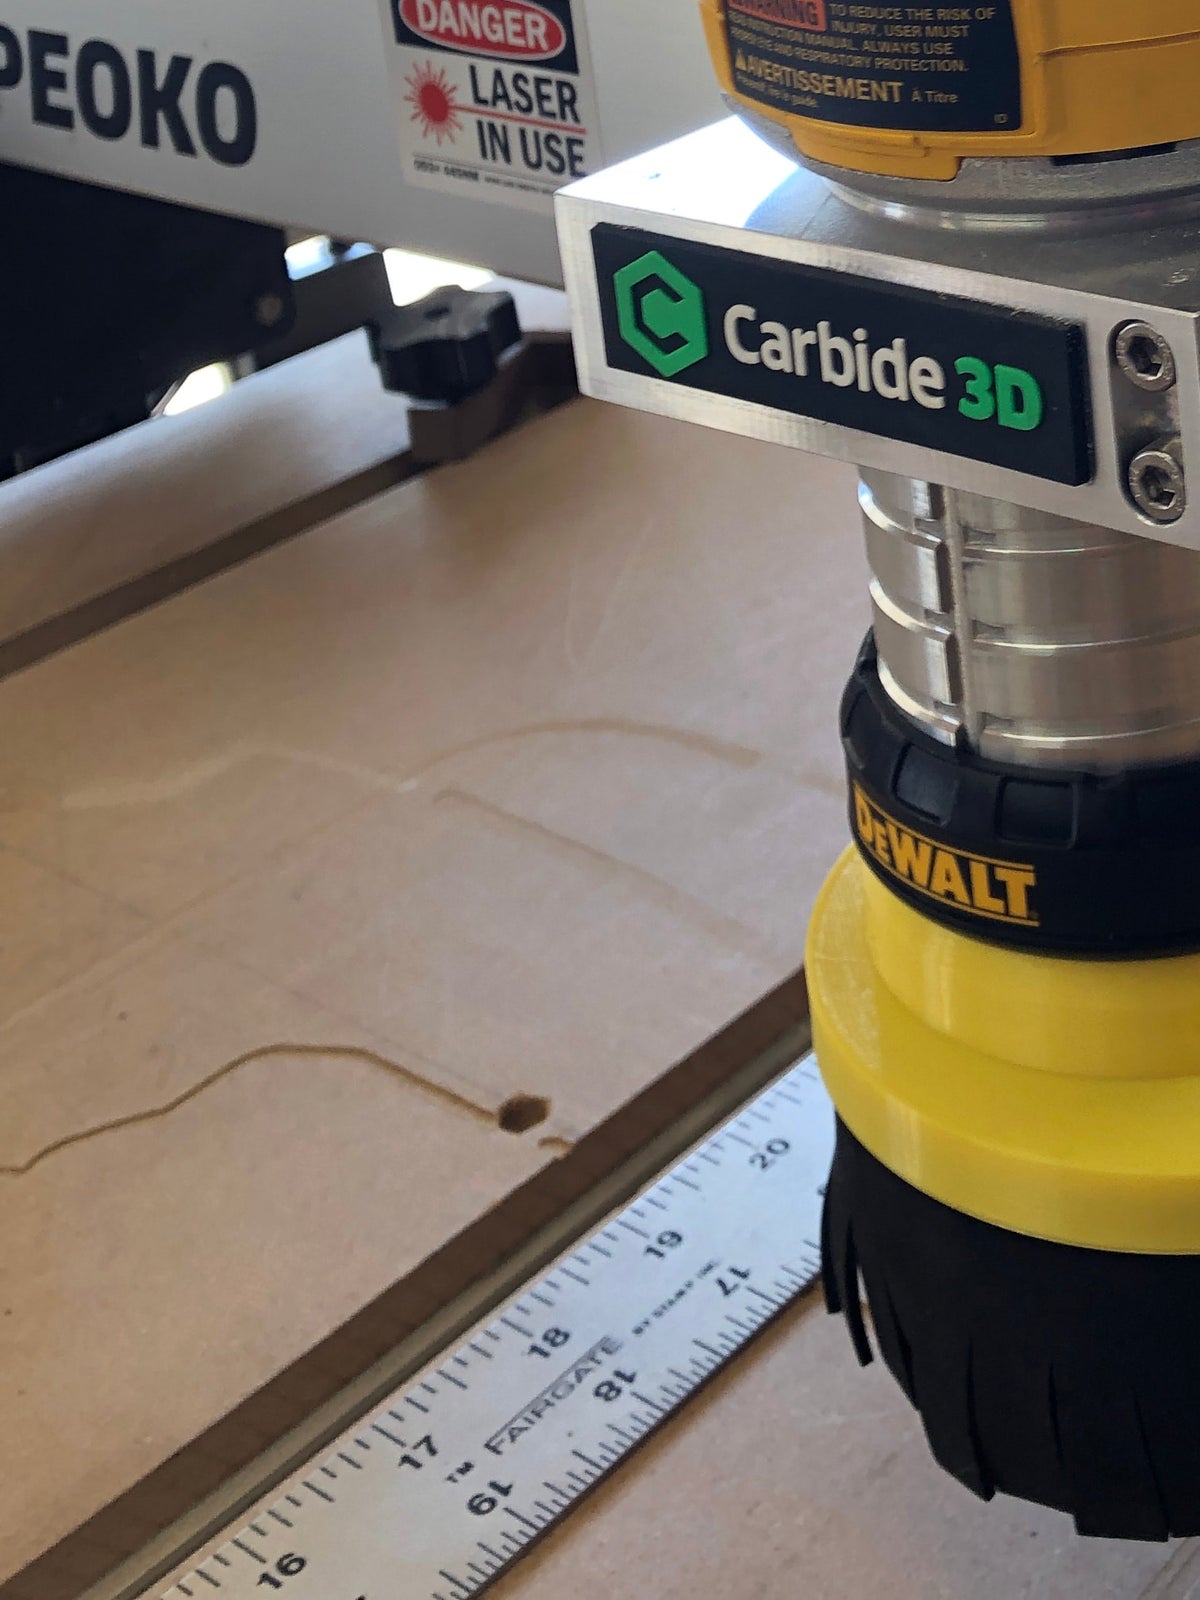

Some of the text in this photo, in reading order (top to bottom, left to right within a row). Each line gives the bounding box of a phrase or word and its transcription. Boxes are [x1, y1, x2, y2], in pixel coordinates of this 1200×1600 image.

[829, 3, 846, 16] TO
[850, 5, 902, 20] REDUCE
[905, 8, 934, 20] THE
[937, 8, 972, 21] RISK
[974, 7, 997, 20] OF
[862, 40, 920, 55] ALWAYS
[923, 42, 955, 55] USE
[884, 24, 923, 37] USER
[925, 25, 970, 38] MUST
[469, 63, 581, 123] LASER
[746, 53, 904, 104] AVERTISSEMENT
[476, 119, 512, 164] IN
[519, 127, 588, 178] USE
[723, 303, 1043, 431] Carbide 3D
[750, 1138, 791, 1171] 20
[643, 1229, 683, 1260] 19
[715, 1264, 751, 1297] 17
[527, 1327, 571, 1358] 18
[484, 1335, 624, 1456] FAIRGATE
[593, 1369, 638, 1402] 18
[398, 1434, 439, 1470] 17
[466, 1480, 514, 1516] 19
[256, 1552, 308, 1590] 16
